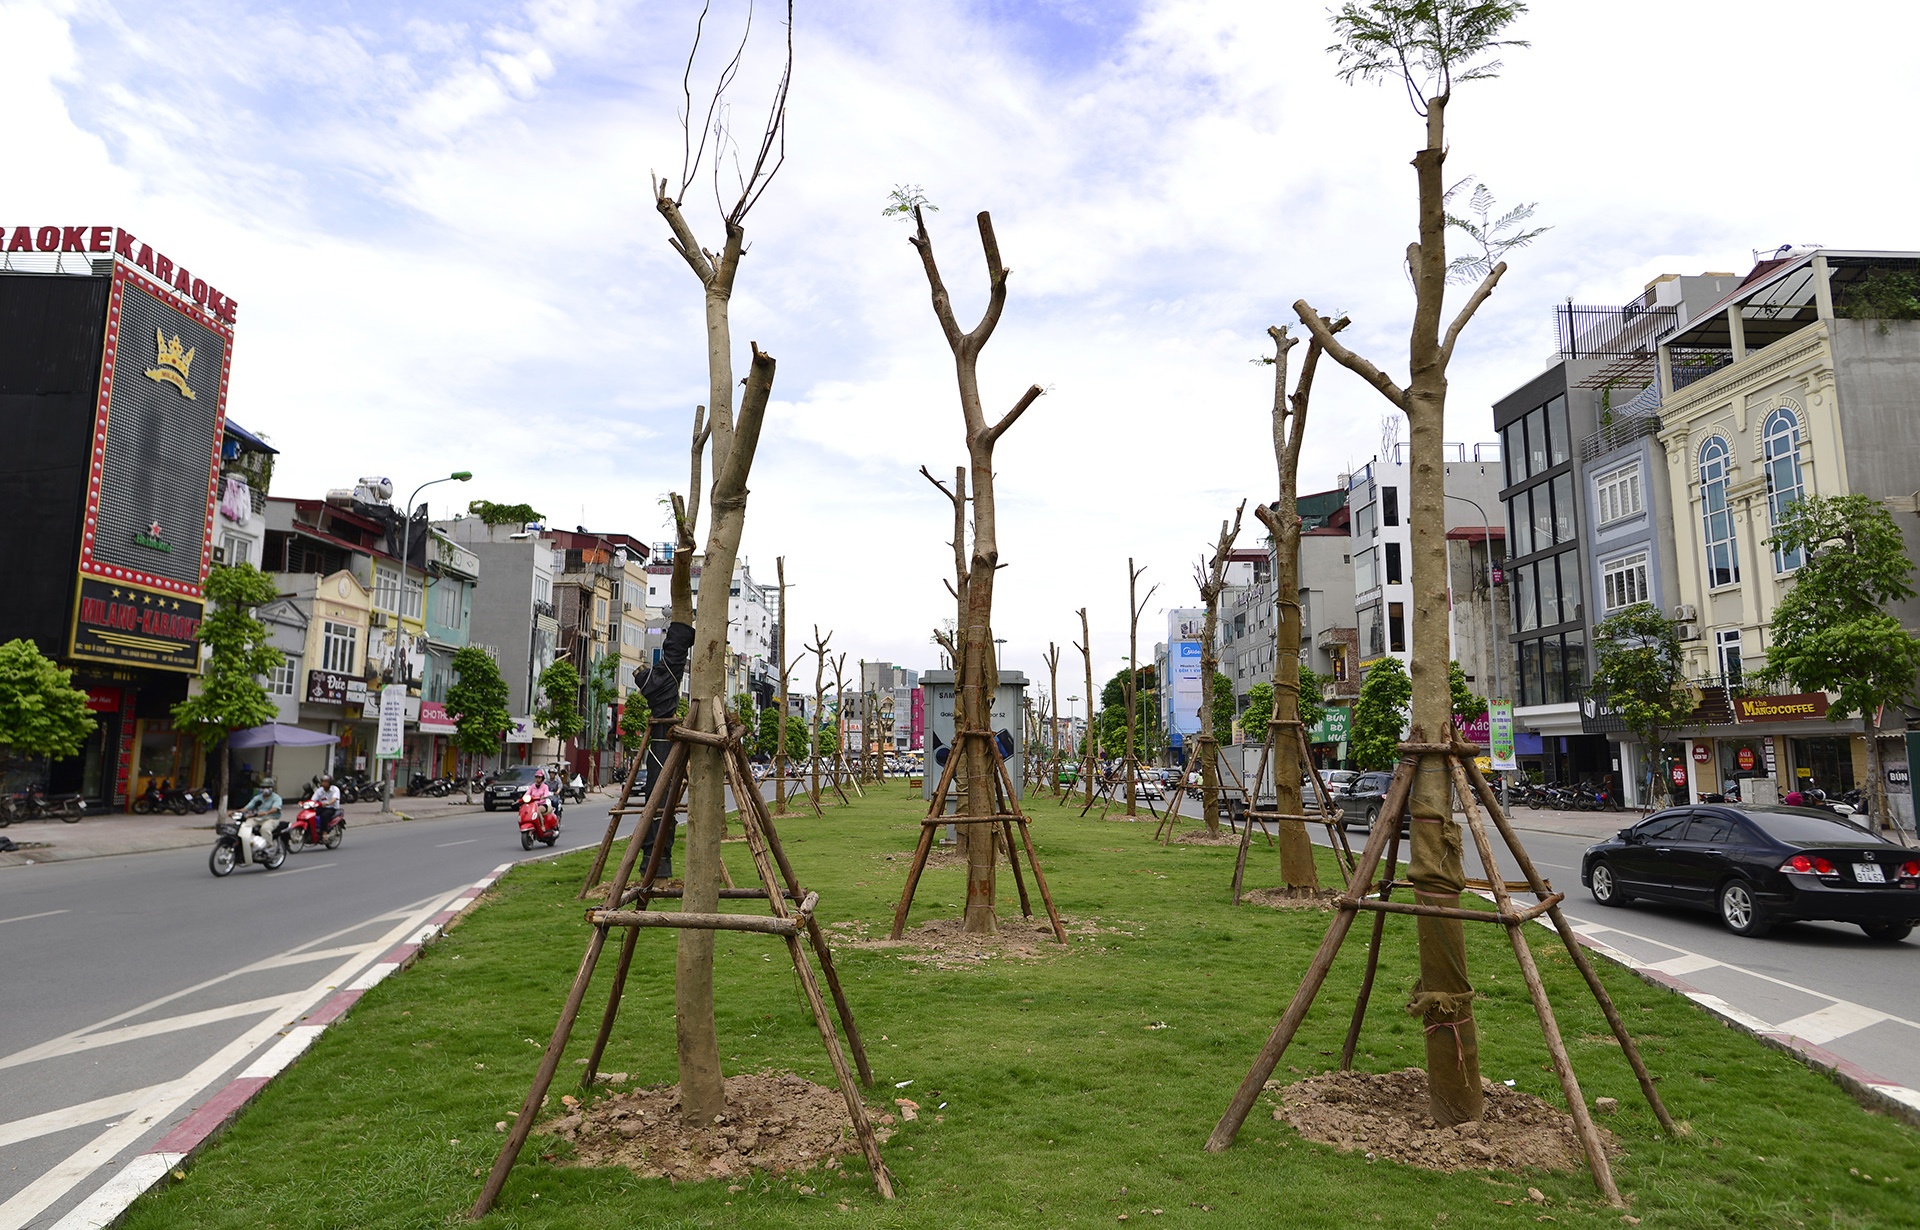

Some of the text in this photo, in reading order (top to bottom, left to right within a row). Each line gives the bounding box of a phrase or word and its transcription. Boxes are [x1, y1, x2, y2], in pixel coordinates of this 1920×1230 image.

[0, 226, 113, 252] AOKE
[115, 227, 238, 324] KARAOKE
[161, 371, 183, 386] MILANO
[135, 533, 173, 553] Heineken
[327, 674, 346, 690] Đức
[423, 708, 437, 719] CHO
[1326, 712, 1347, 722] BÚN
[1330, 721, 1343, 732] BÒ
[1470, 718, 1489, 731] Xác
[1327, 730, 1347, 742] HUẾ
[1889, 770, 1908, 781] BÚN
